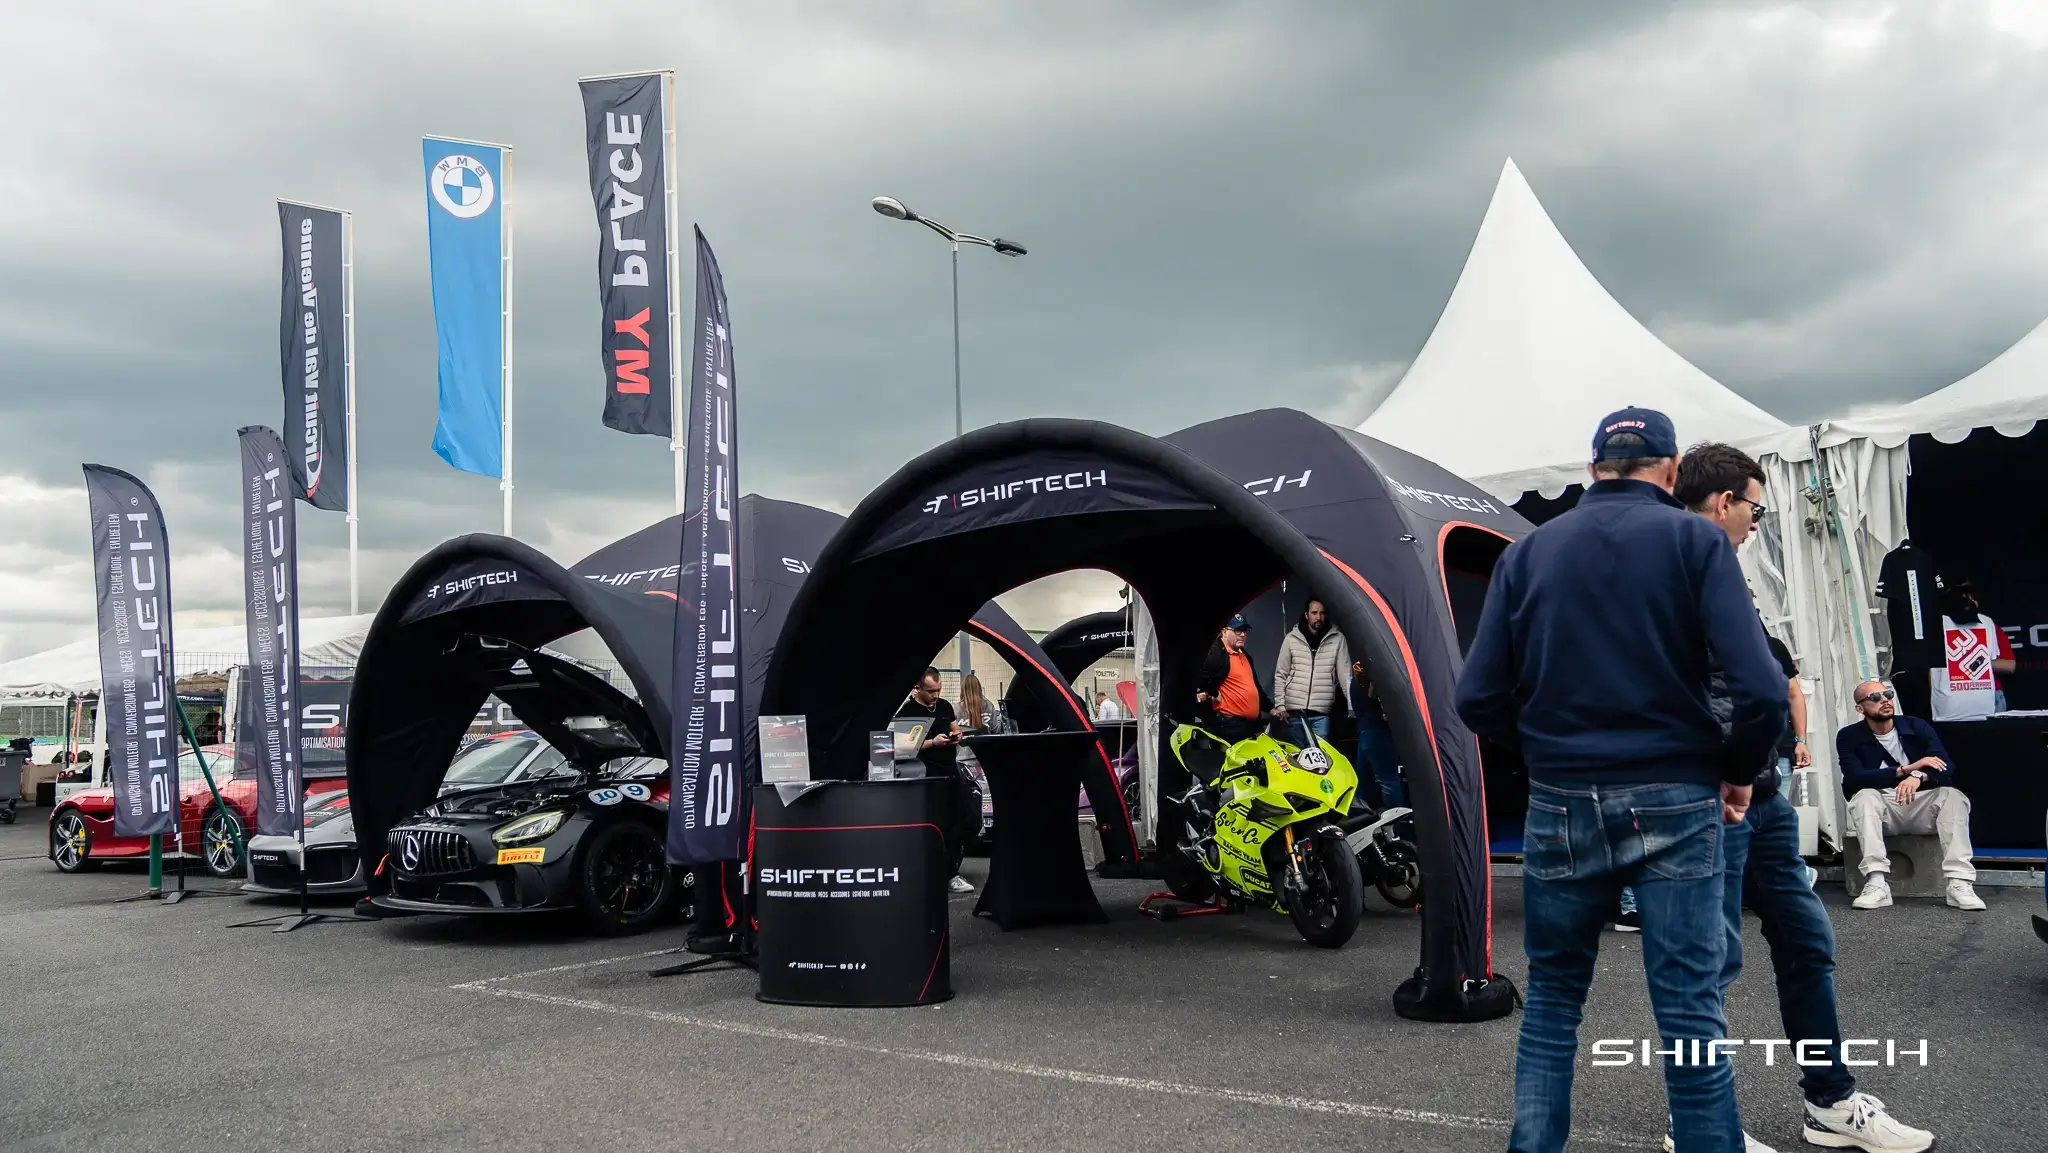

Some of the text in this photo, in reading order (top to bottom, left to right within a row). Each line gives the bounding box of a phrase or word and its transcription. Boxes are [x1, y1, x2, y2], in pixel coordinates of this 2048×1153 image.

[960, 470, 1107, 507] SHIFTECH
[1385, 475, 1500, 515] SHIFTECH
[445, 570, 518, 595] SHIFTECH
[1950, 682, 1970, 691] 500
[301, 736, 346, 749] OPTIMISATION
[594, 790, 617, 802] 10
[627, 785, 644, 796] 9
[501, 851, 541, 862] PIRELLI
[1222, 839, 1261, 865] RACING TEAM
[760, 867, 899, 884] SHIFTECH
